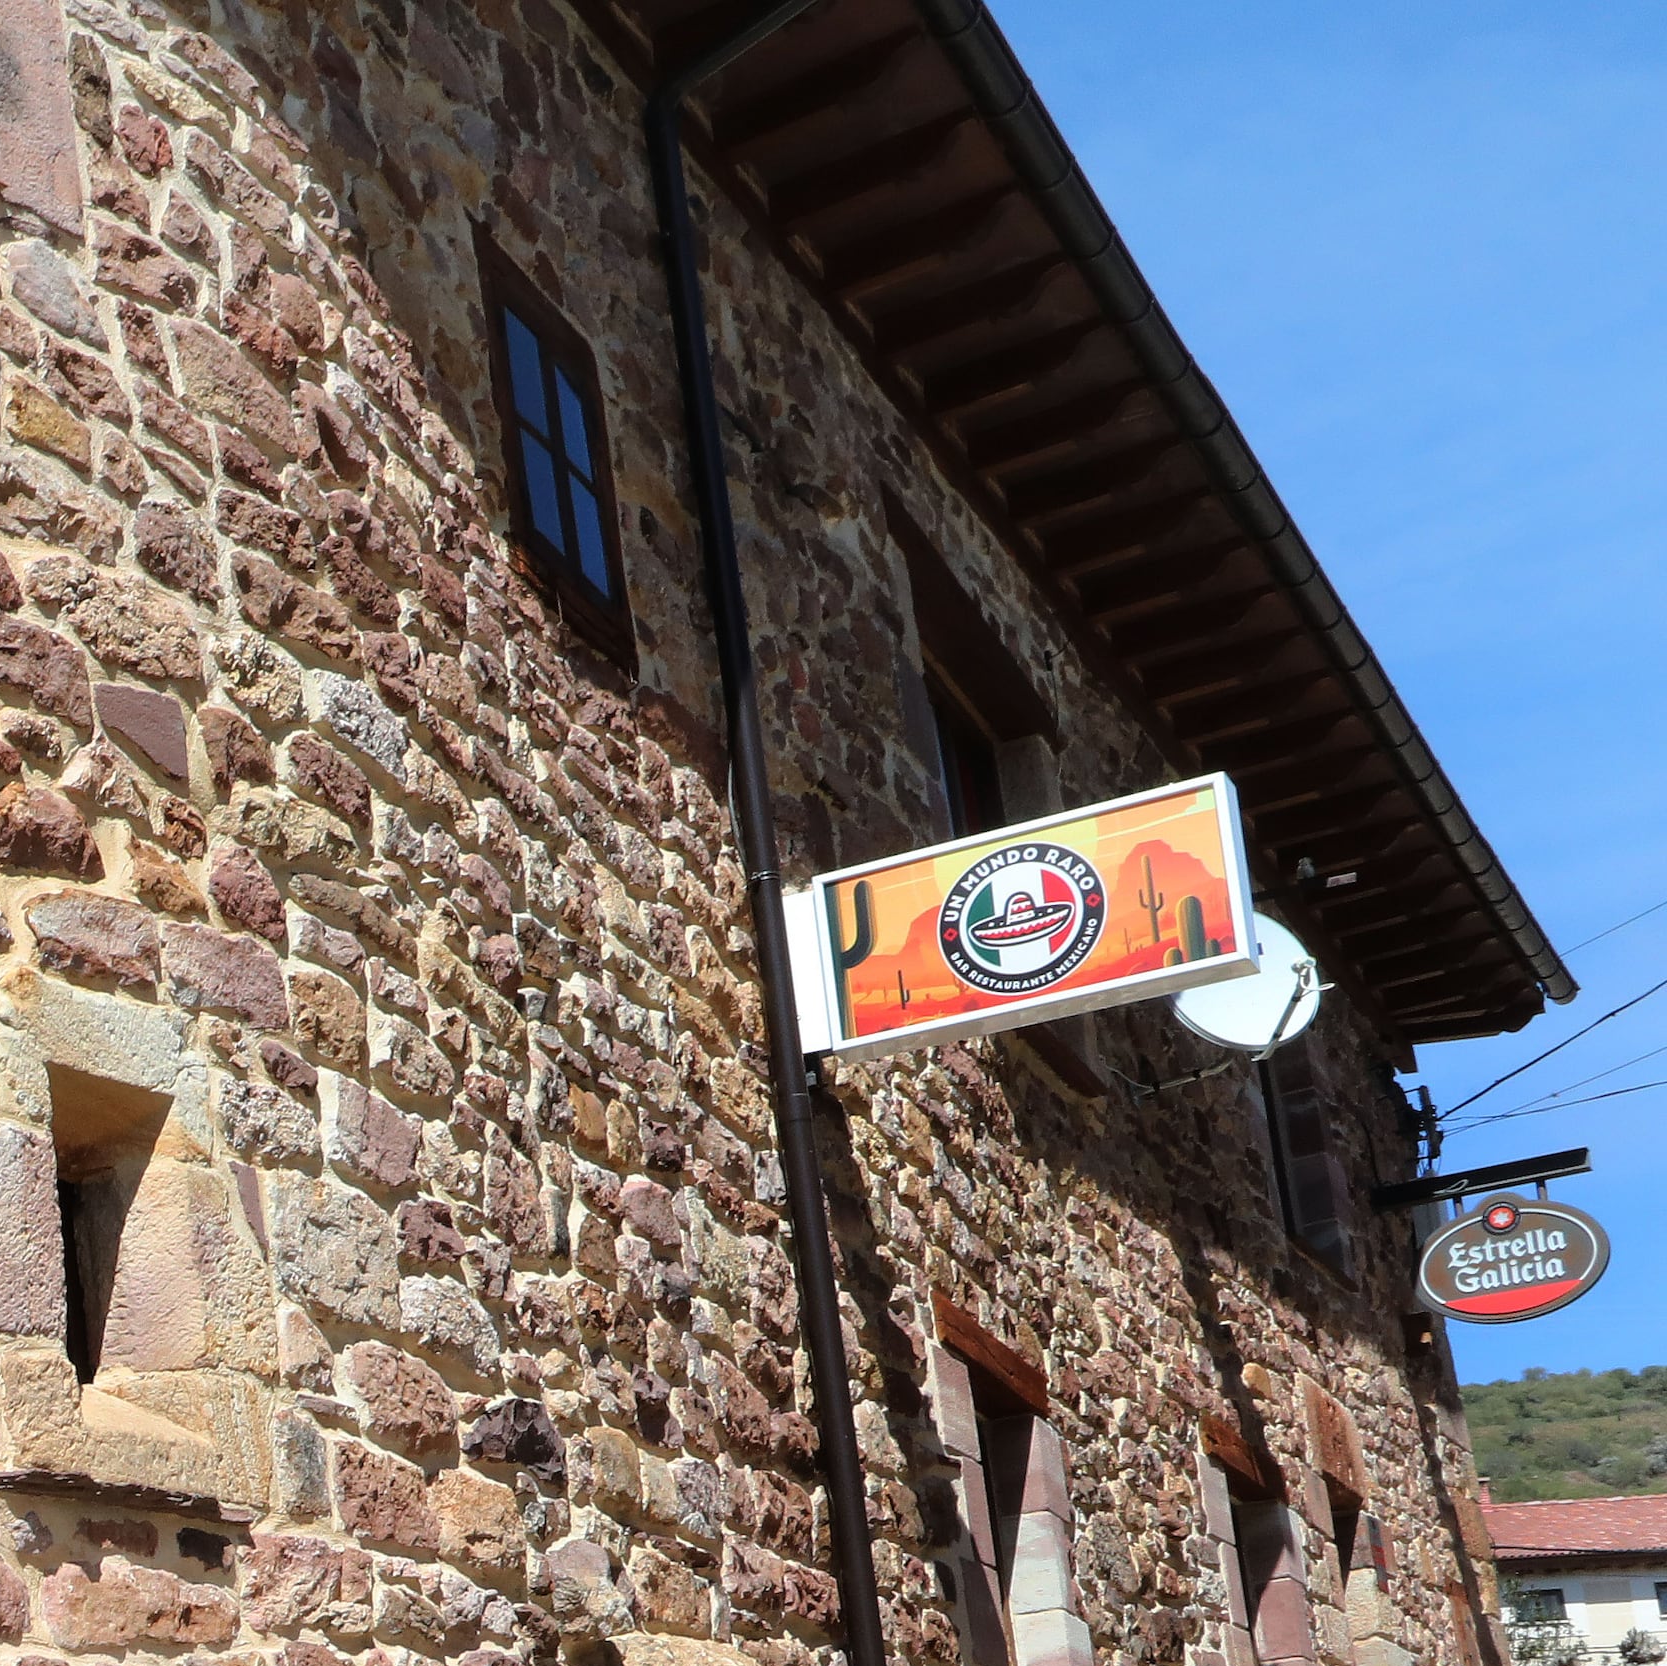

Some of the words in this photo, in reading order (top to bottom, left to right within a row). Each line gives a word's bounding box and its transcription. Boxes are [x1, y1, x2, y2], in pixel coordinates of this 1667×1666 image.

[944, 895, 965, 922] UN
[961, 847, 1038, 891] MUNDO
[1044, 849, 1095, 890] RARO
[950, 952, 968, 973] BAR
[968, 970, 1055, 990] RESTAURANTE
[1055, 918, 1098, 976] MEXICANO
[1447, 1228, 1567, 1269] Estrella
[1455, 1255, 1566, 1293] Galicia
